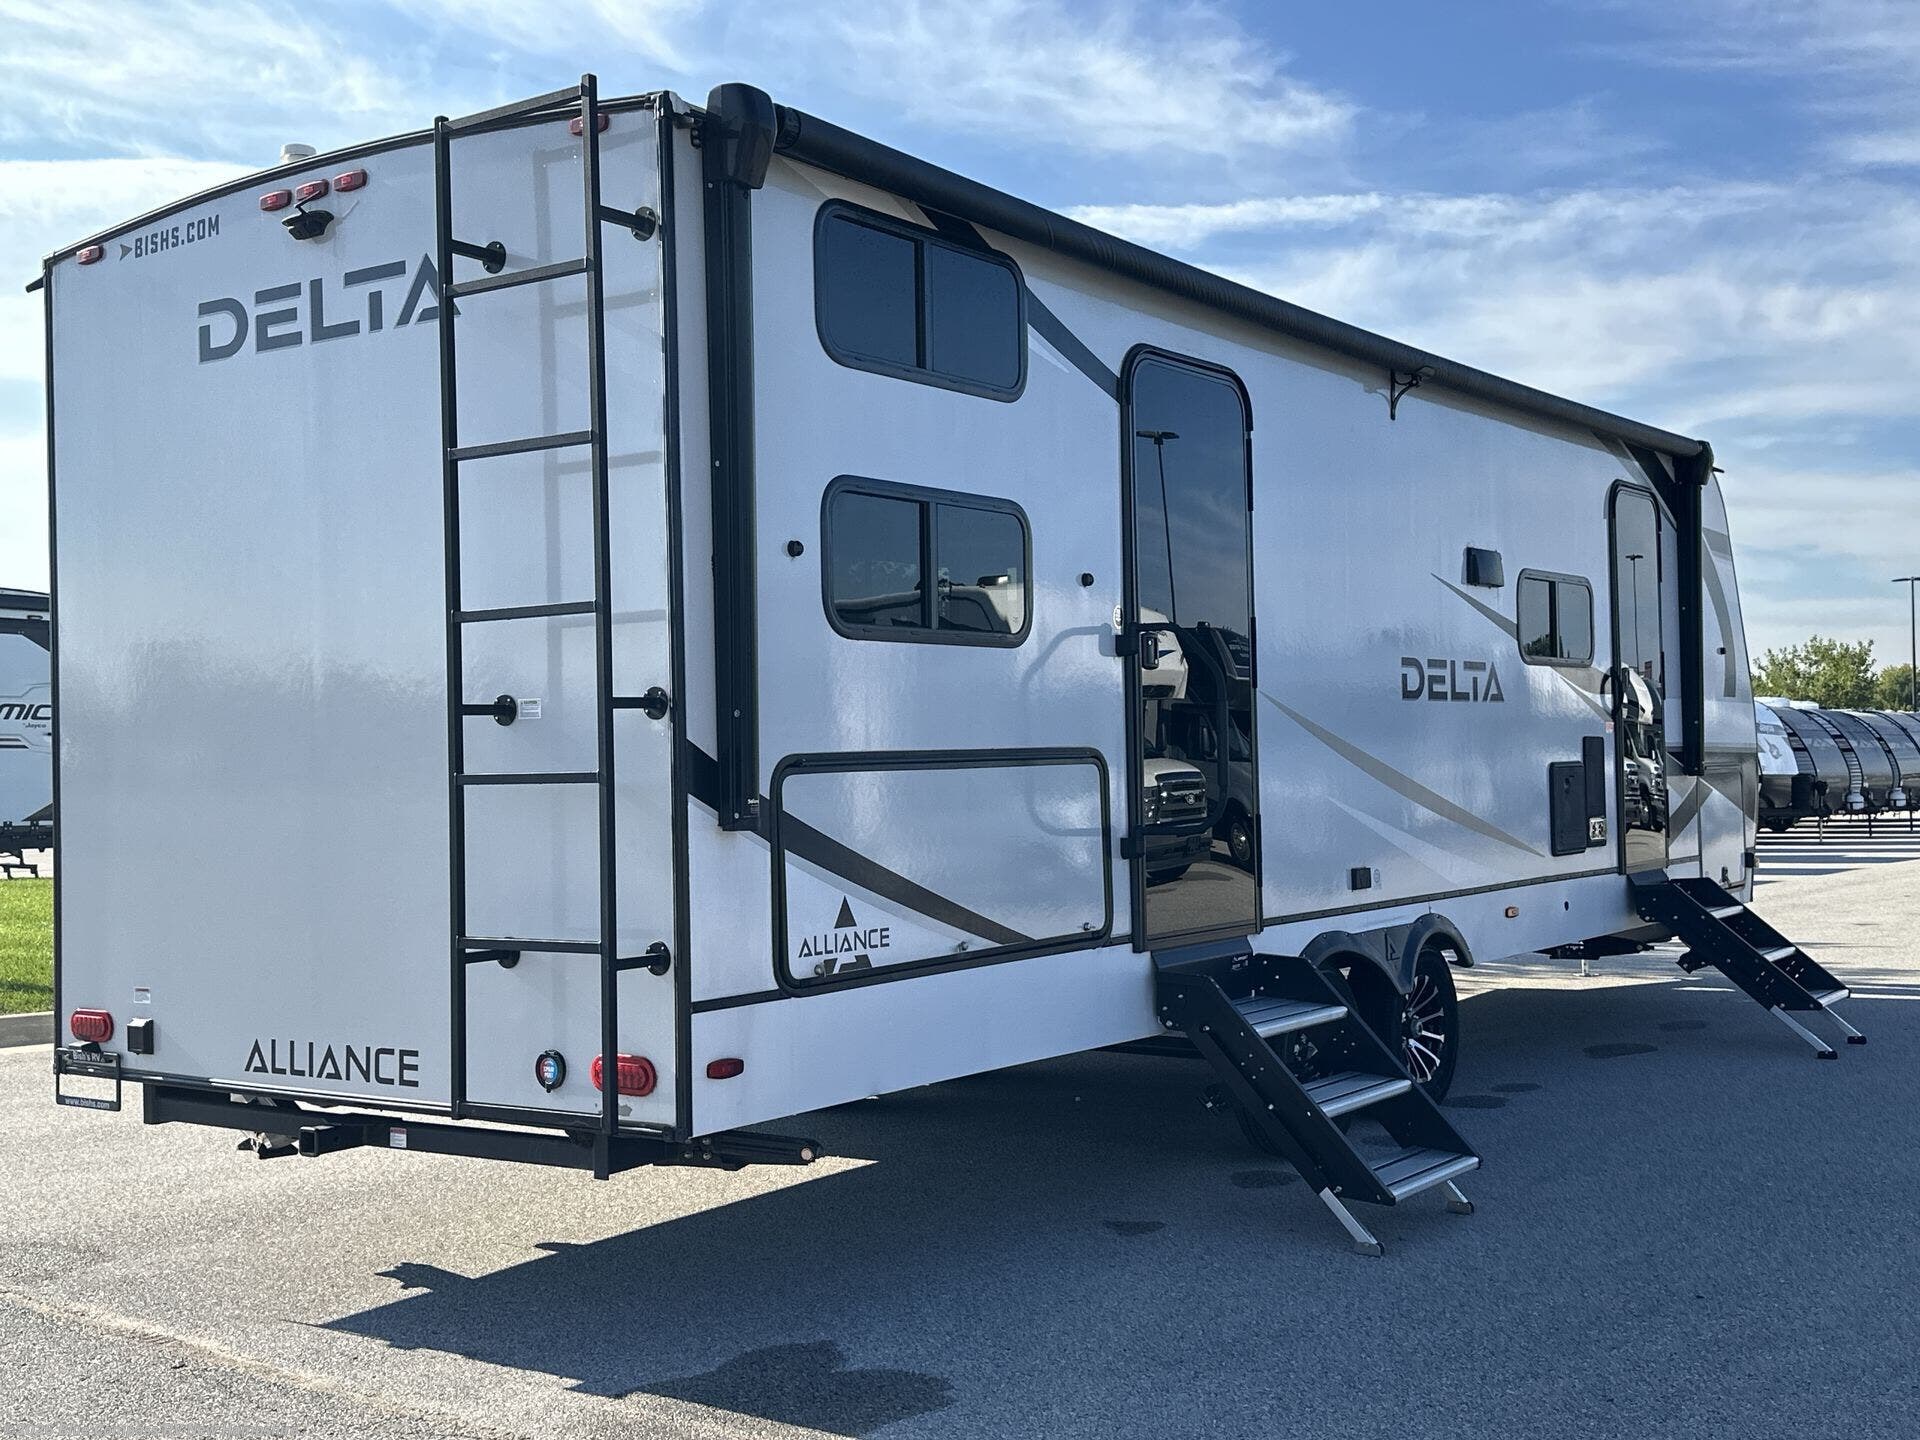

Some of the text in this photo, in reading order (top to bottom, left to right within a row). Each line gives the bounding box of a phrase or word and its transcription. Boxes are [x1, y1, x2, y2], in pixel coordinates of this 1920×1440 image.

[134, 214, 220, 258] BISHS.COM
[198, 252, 462, 364] DELTA
[1401, 656, 1505, 702] DELTA
[798, 927, 890, 958] ALLIANCE
[91, 1052, 101, 1062] RV
[244, 1038, 419, 1088] ALLIANCE
[65, 1098, 110, 1109] www.bishs.com
